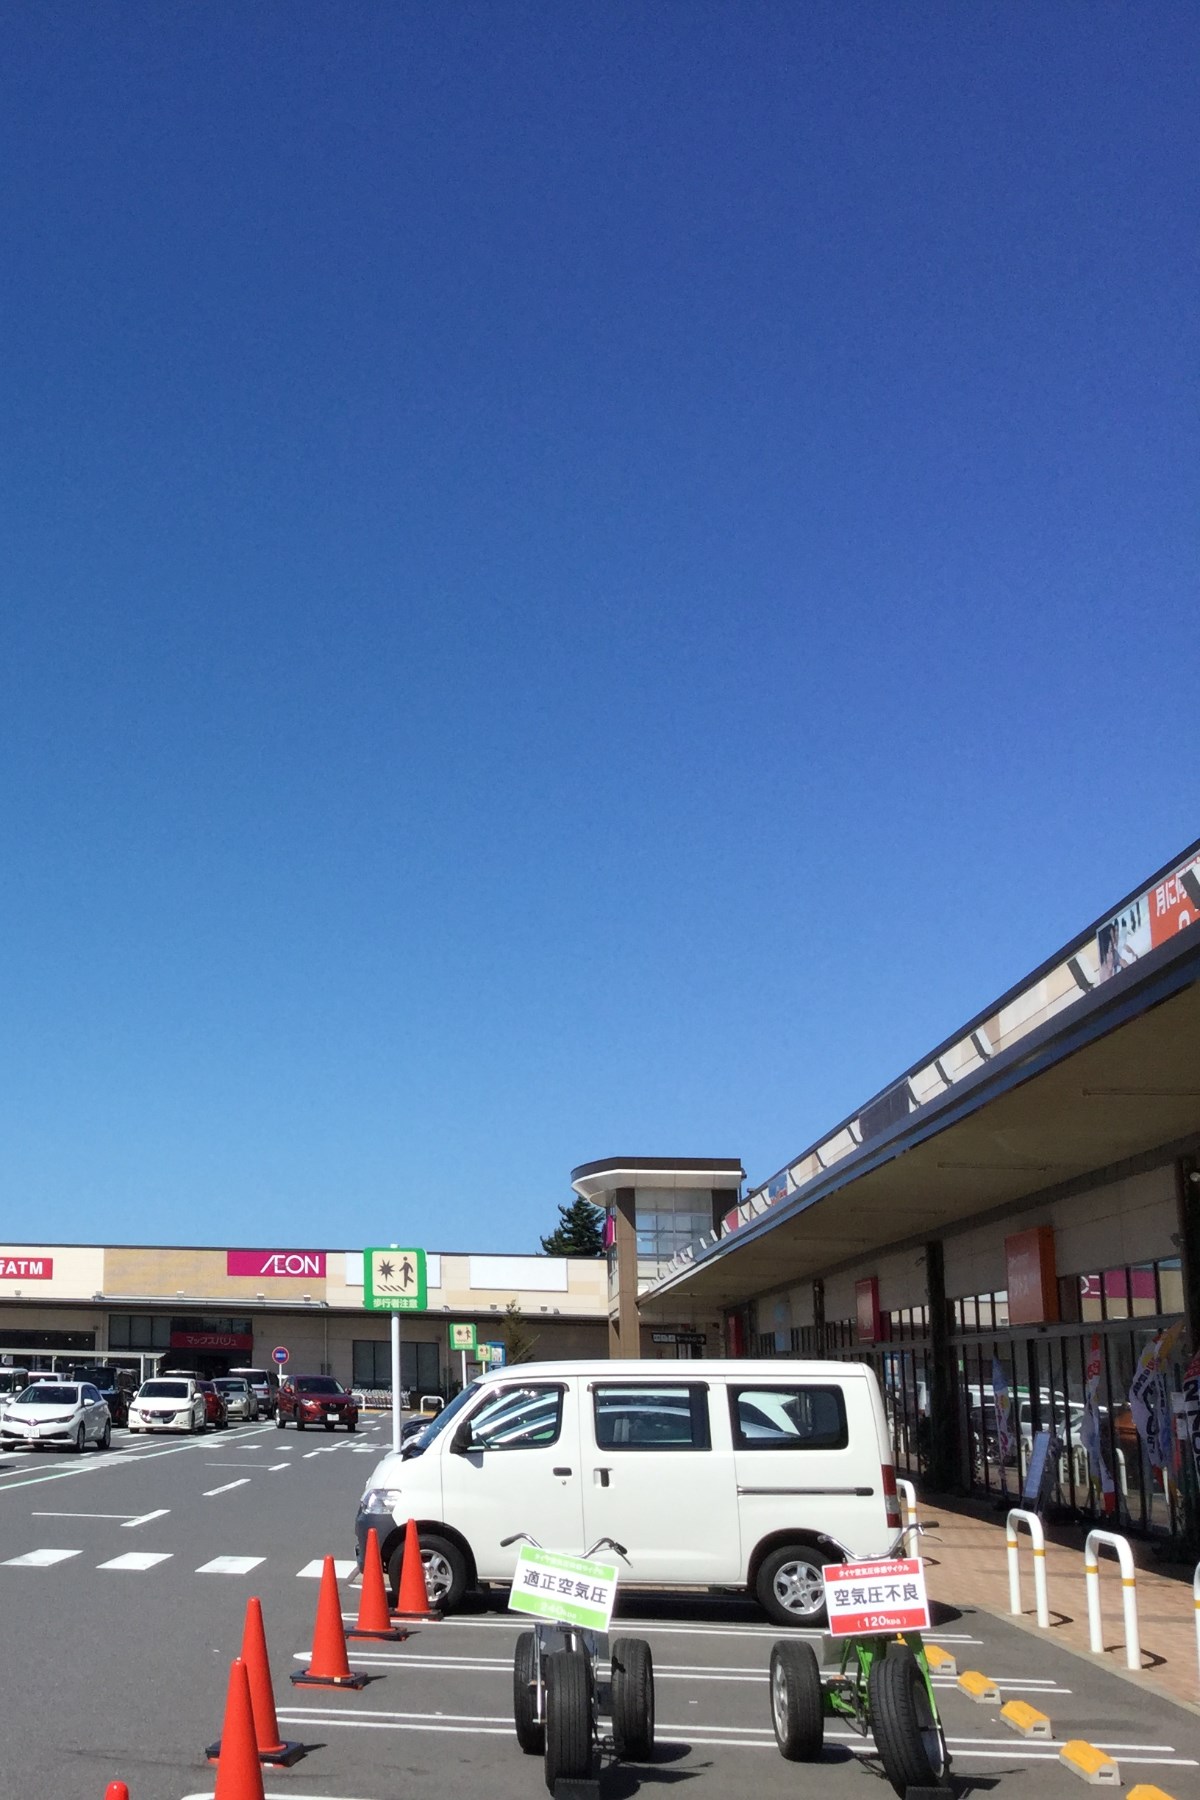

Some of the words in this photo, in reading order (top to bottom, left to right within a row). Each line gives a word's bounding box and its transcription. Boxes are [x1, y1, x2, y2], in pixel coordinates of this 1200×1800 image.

[372, 1298, 418, 1309] 歩行者注意
[186, 1335, 238, 1347] マックスバリュ
[523, 1568, 608, 1605] 適正空気圧
[834, 1583, 919, 1607] 空気圧不良
